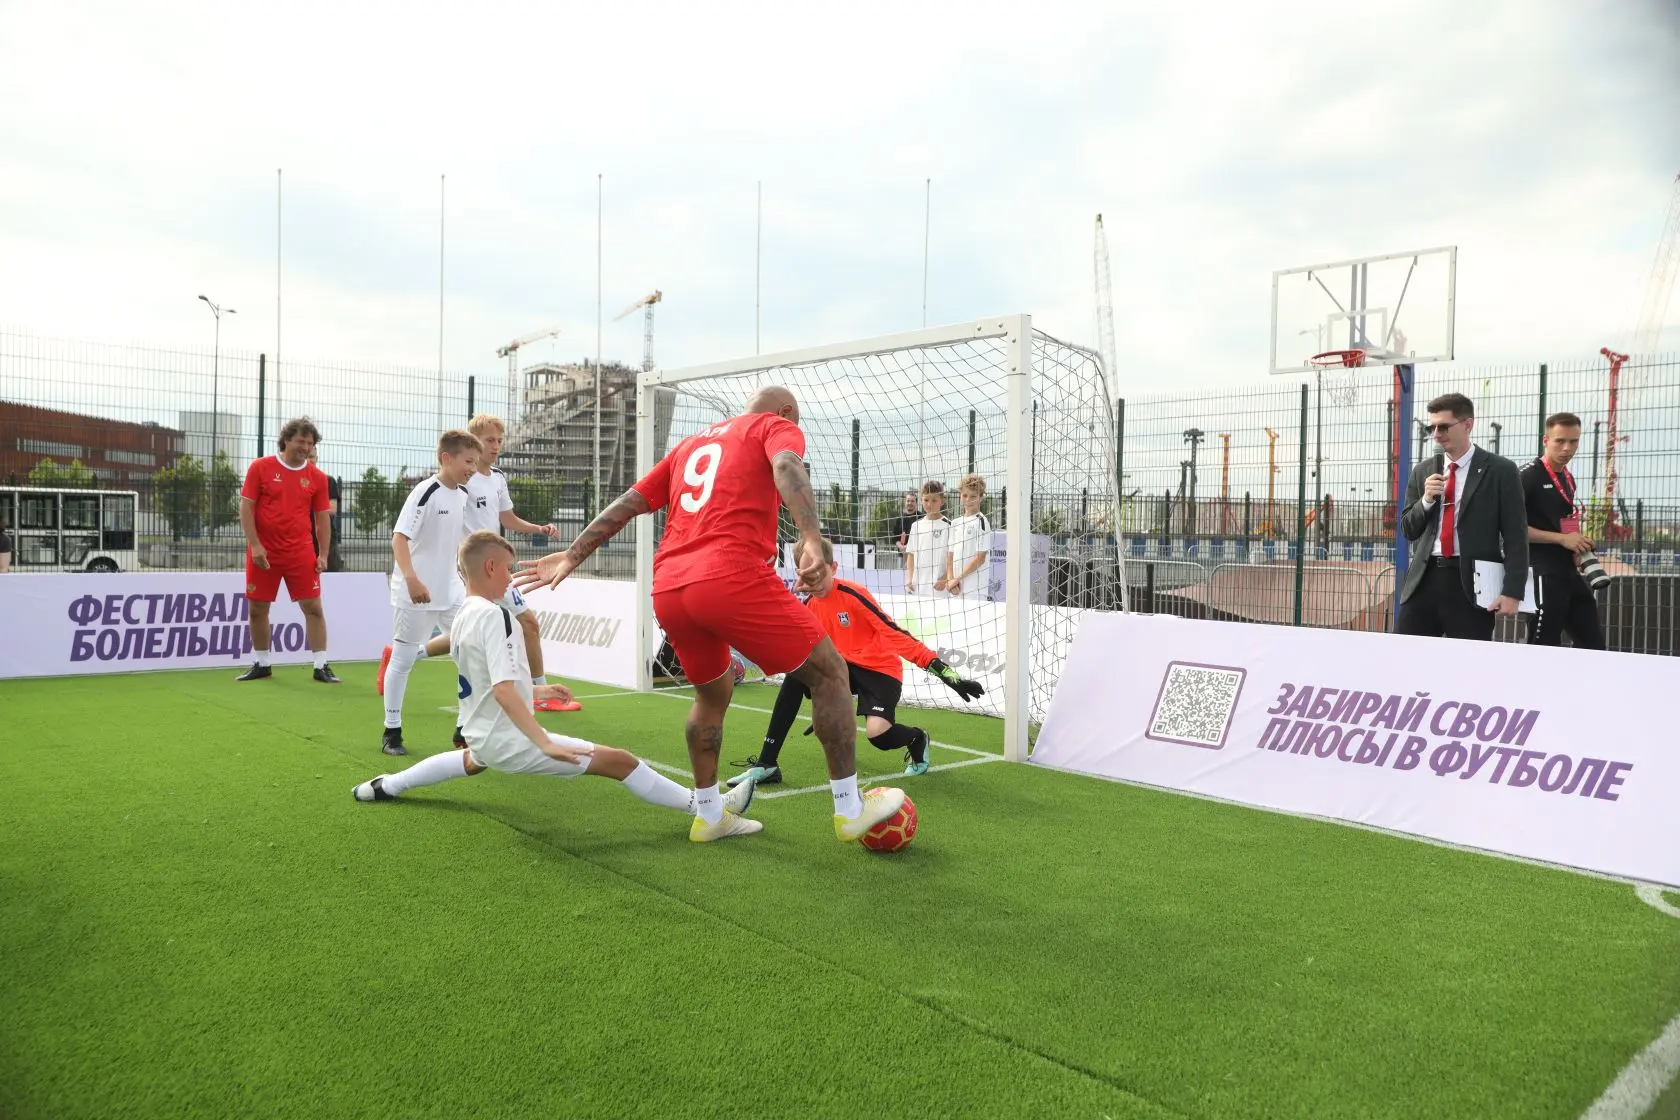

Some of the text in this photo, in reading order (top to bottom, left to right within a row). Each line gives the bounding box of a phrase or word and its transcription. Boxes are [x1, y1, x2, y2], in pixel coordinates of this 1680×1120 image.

[680, 443, 722, 513] 9
[68, 593, 250, 626] ФЕСТИВАЛ
[551, 612, 622, 649] ПЛЮСЫ
[70, 622, 311, 662] БОЛЕЛЬЩКО
[1267, 683, 1540, 746] ЗАБИРАЙ СВОИ
[1256, 717, 1634, 801] ПЛЮСЫ В ФУТБОЛЕ
